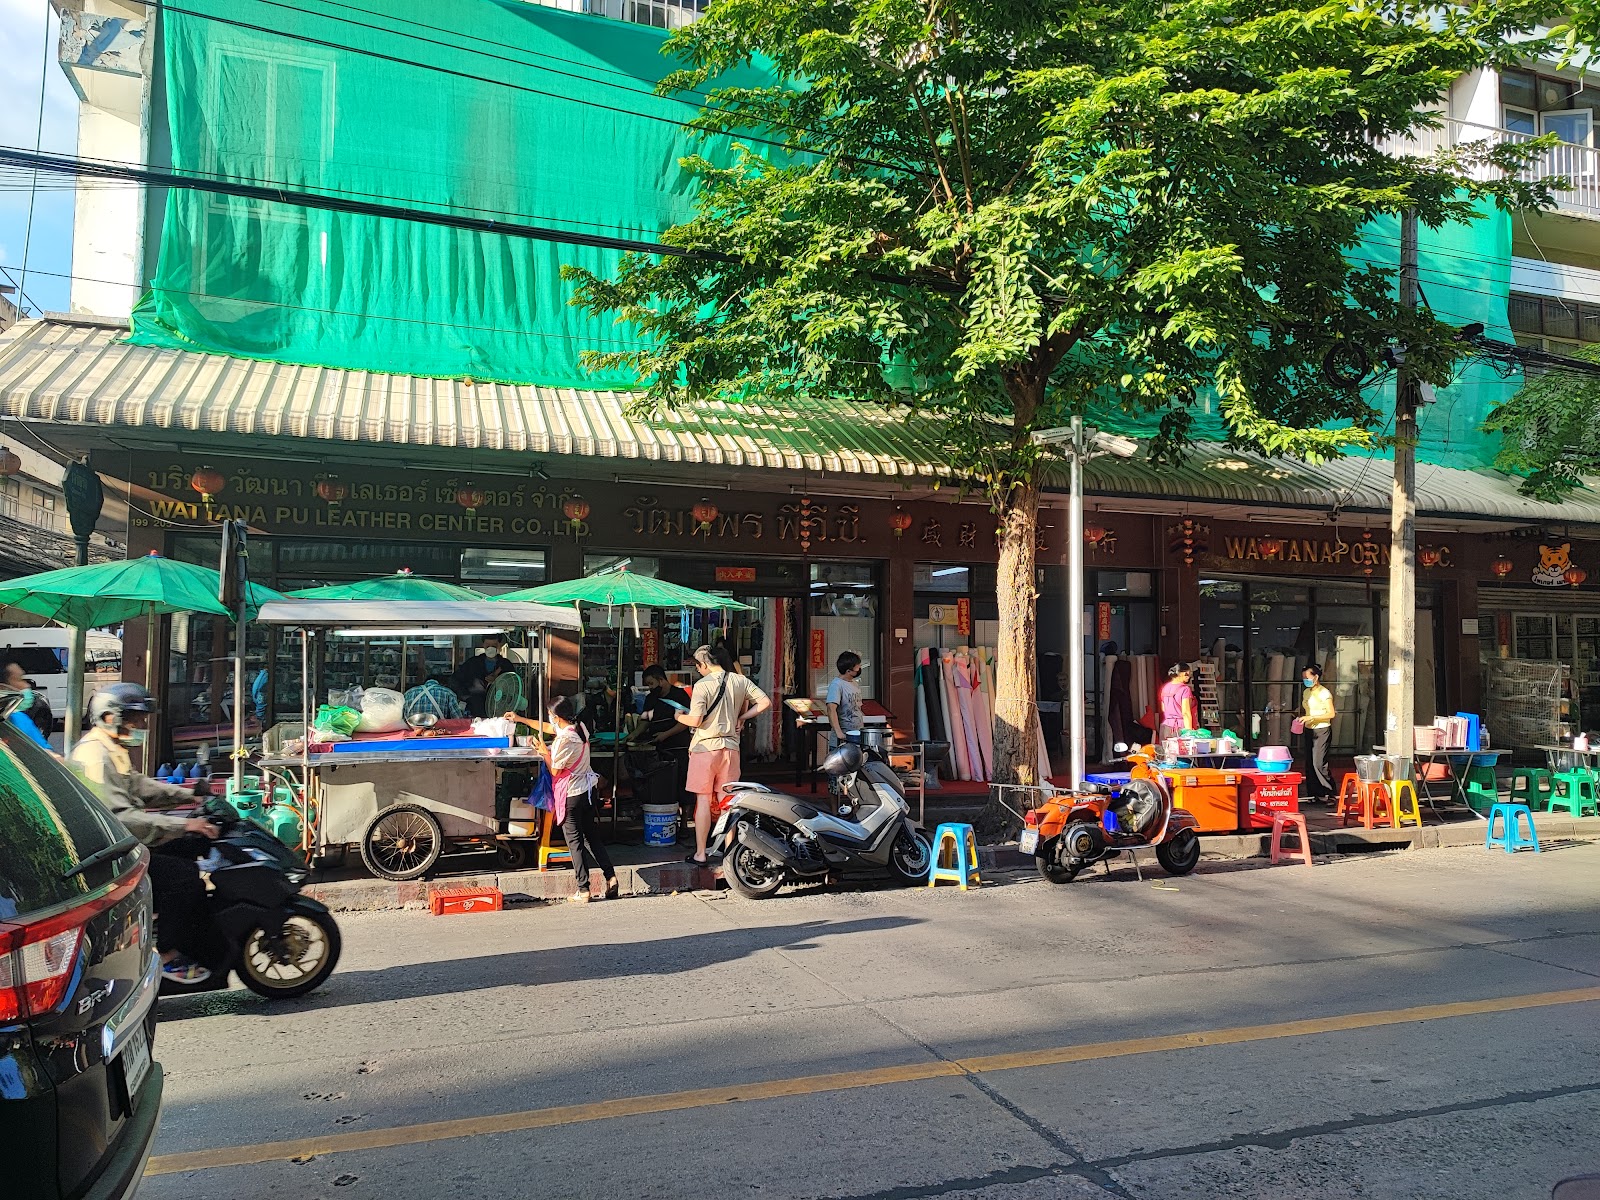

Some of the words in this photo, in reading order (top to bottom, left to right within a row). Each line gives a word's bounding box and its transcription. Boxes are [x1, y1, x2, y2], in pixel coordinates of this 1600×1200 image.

[229, 468, 302, 496] วัฒนา
[351, 478, 430, 502] เลเธอร์
[131, 518, 149, 527] 199
[149, 500, 267, 523] WATTANA
[276, 506, 309, 525] PU
[316, 508, 411, 529] LEATHER
[419, 513, 504, 533] CENTER
[1225, 535, 1392, 566] WATANAPORN
